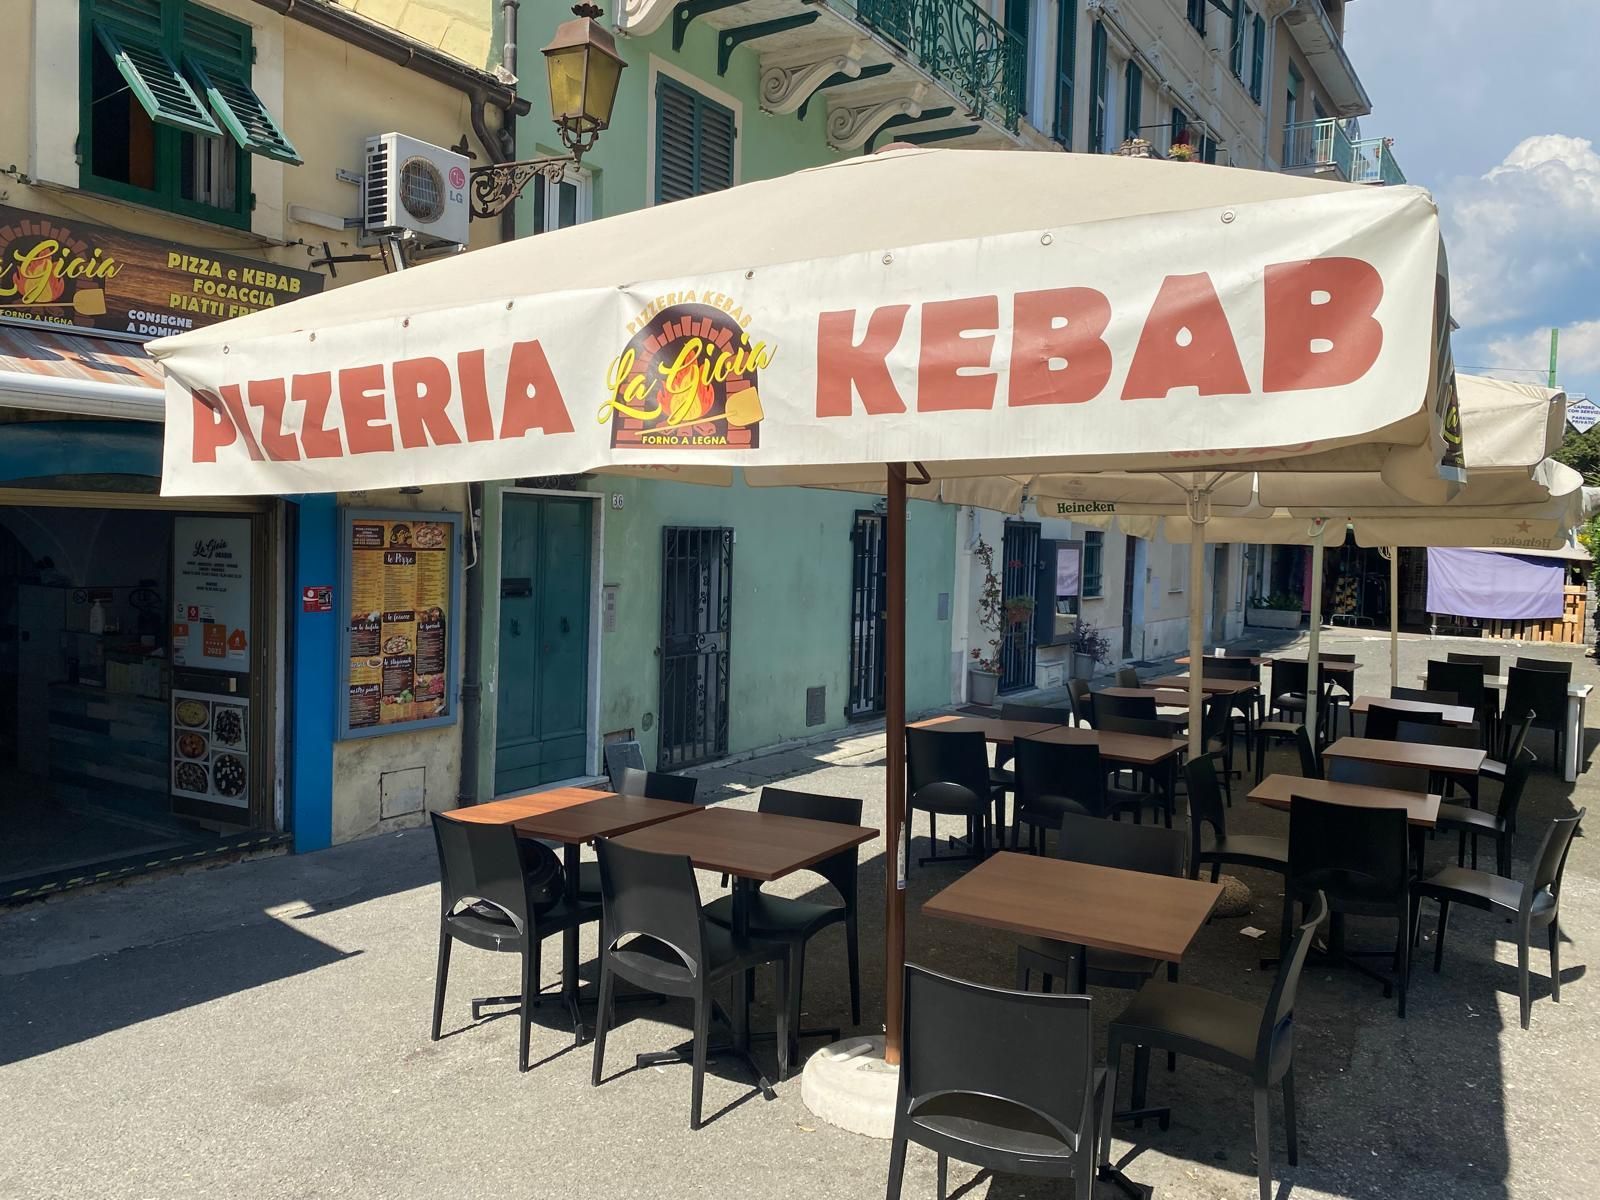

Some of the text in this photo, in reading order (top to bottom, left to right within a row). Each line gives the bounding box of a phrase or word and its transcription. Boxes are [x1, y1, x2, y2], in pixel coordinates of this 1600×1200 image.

[449, 190, 464, 204] LG
[13, 239, 125, 305] Gioia
[167, 251, 301, 294] PIZZA e KEBAB
[169, 293, 225, 316] PIATTI
[192, 278, 275, 307] FOCACCIA
[126, 322, 136, 332] A
[128, 309, 193, 329] CONSEGNE
[626, 289, 753, 336] PIZZERIA KEBAB
[815, 256, 1385, 418] KEBAB
[597, 332, 778, 426] La Gioia
[191, 338, 576, 464] PIZZERIA
[641, 436, 727, 445] FORNO A LEGNA
[1057, 501, 1116, 514] Heineken
